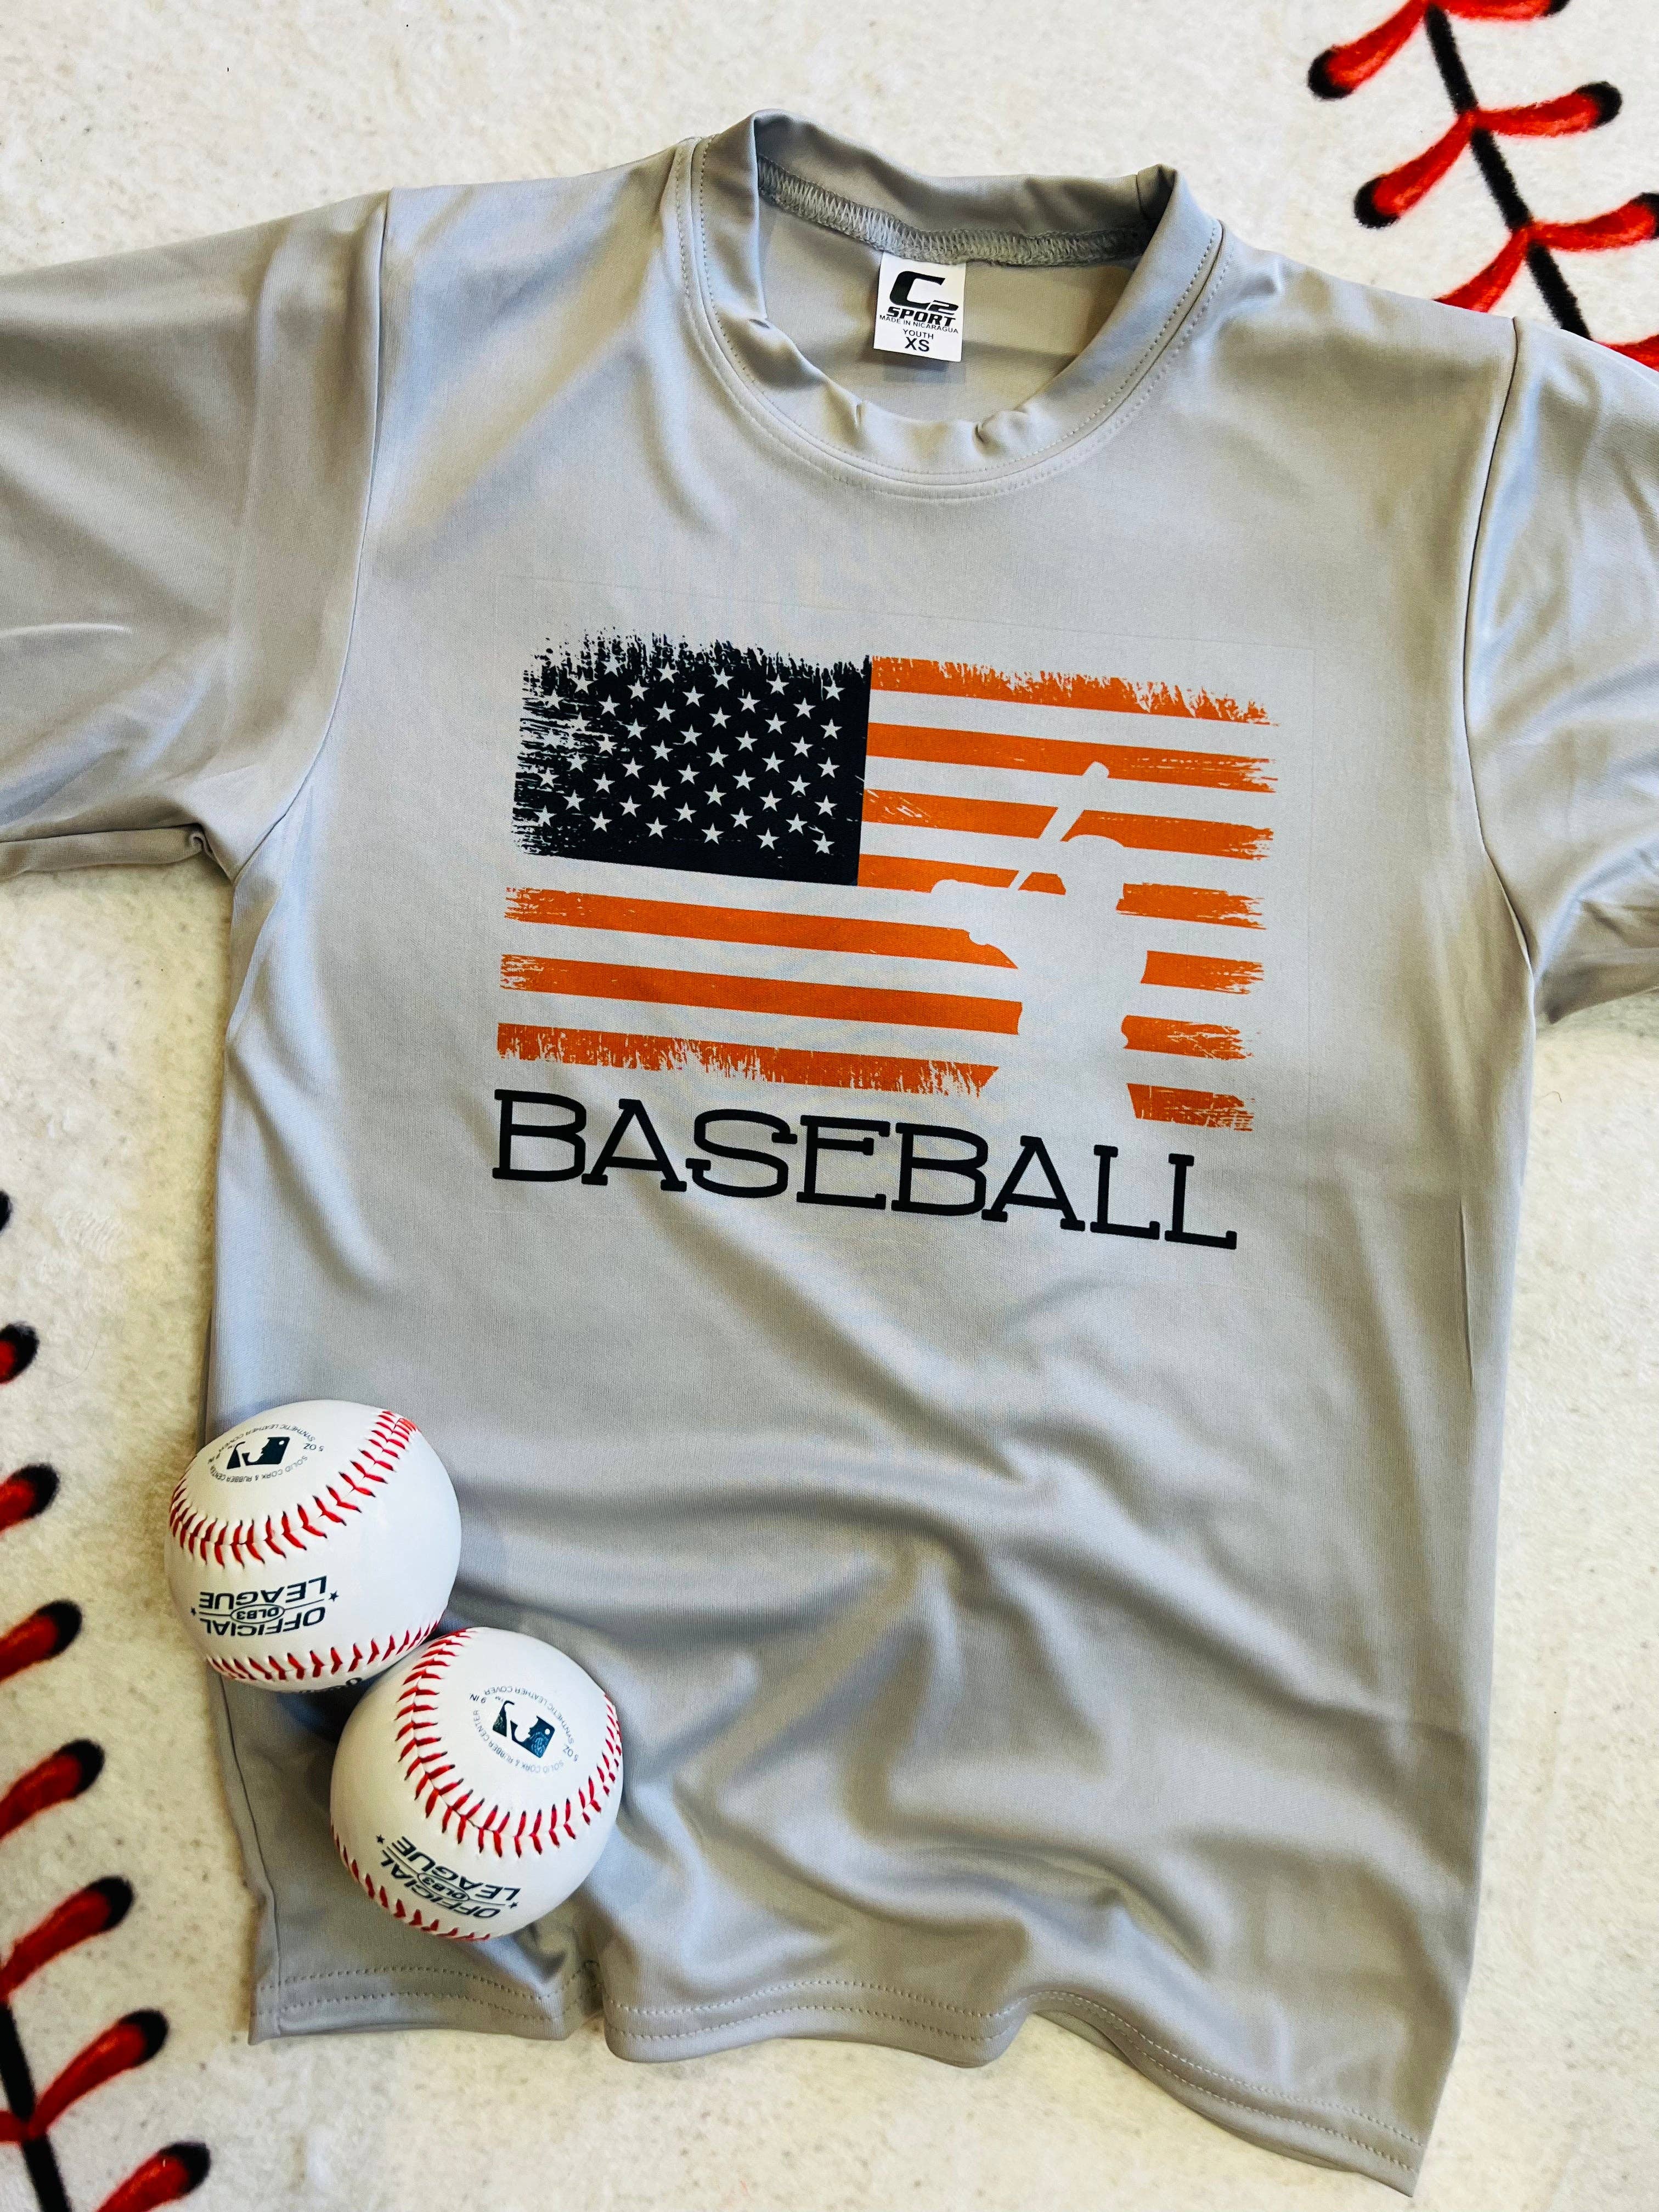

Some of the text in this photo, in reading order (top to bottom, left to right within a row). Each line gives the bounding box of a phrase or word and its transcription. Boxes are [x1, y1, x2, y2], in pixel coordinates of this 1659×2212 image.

[879, 314, 900, 324] MADE
[913, 321, 959, 334] NICARAGUA
[886, 306, 956, 327] SPORT
[902, 329, 934, 340] YOUTH
[905, 337, 930, 352] XS
[492, 1089, 1238, 1250] BASEBALL
[285, 1455, 307, 1472] SOLID
[199, 1575, 327, 1610] LEAGUE
[199, 1606, 326, 1637] OFFICIAL
[484, 1685, 513, 1695] COVER
[515, 1686, 548, 1706] LEATHER
[473, 1709, 490, 1741] CENTER
[392, 1836, 521, 1901] LEAGUE
[380, 1849, 500, 1918] OFFICIAL
